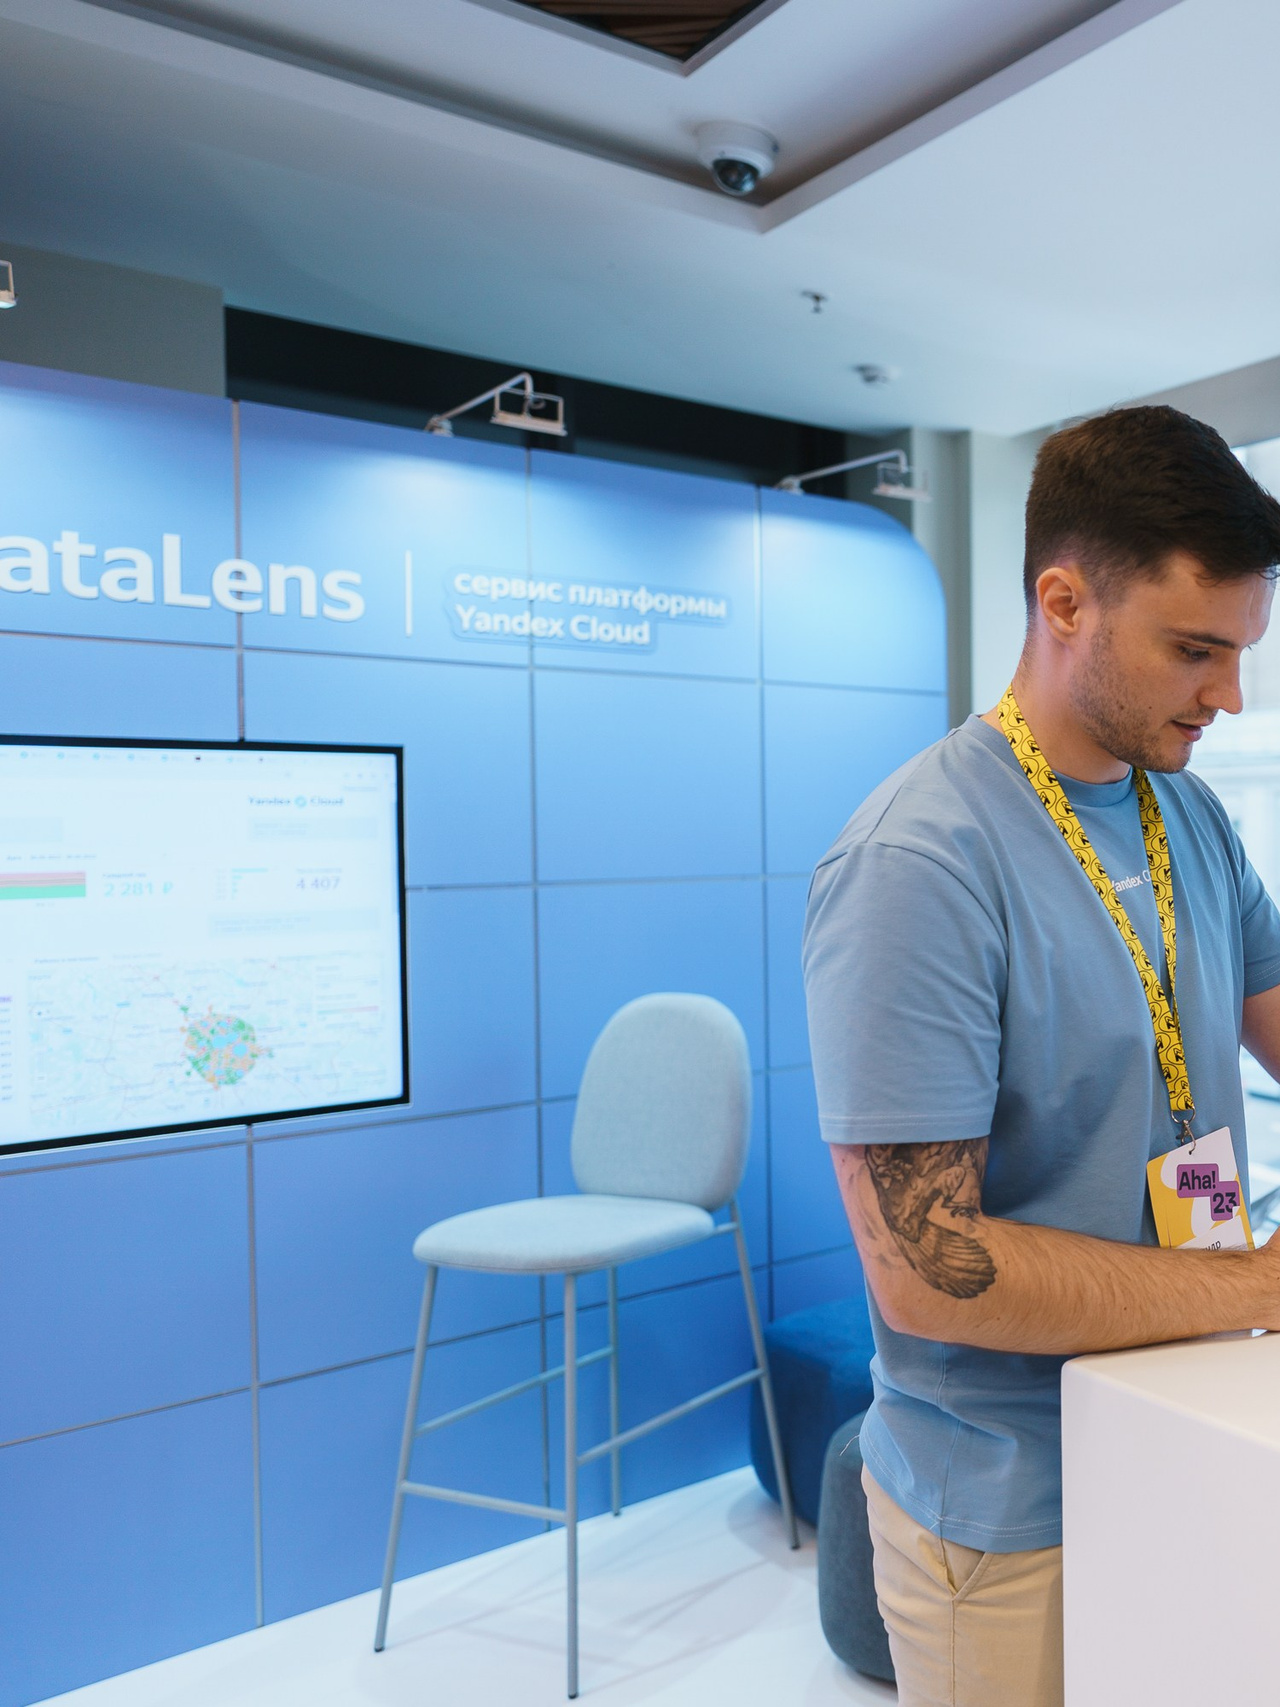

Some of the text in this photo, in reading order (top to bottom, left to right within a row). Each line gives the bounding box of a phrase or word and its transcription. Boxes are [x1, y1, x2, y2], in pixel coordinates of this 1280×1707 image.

[454, 573, 727, 618] сервис платформы
[455, 603, 651, 645] Yandex Cloud
[1178, 1169, 1216, 1191] Aha!
[1212, 1192, 1237, 1214] 23
